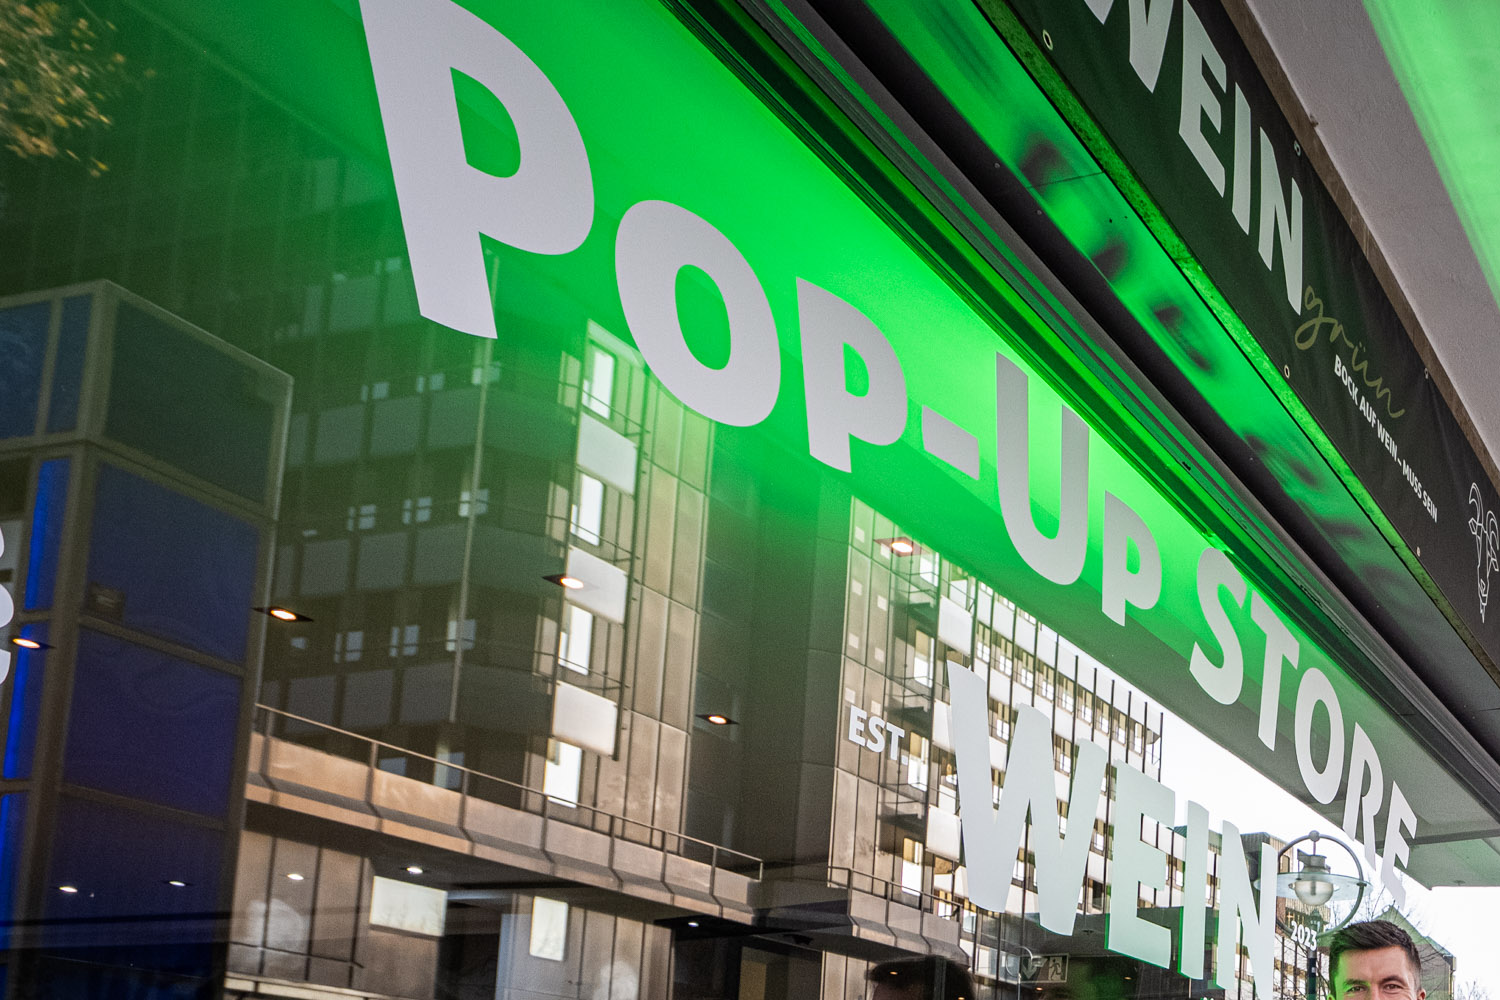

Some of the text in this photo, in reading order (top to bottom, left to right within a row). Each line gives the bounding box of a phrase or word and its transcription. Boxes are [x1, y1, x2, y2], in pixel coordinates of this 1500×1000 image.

[1294, 285, 1405, 418] grün
[1334, 354, 1358, 405] BOCK
[1359, 395, 1377, 429] AUF
[1377, 419, 1398, 462] WEIN
[1402, 459, 1423, 499] MUSS
[1422, 490, 1438, 523] SEIN
[848, 704, 909, 765] EST.
[1189, 547, 1418, 908] STORE
[1290, 919, 1318, 952] 2023
